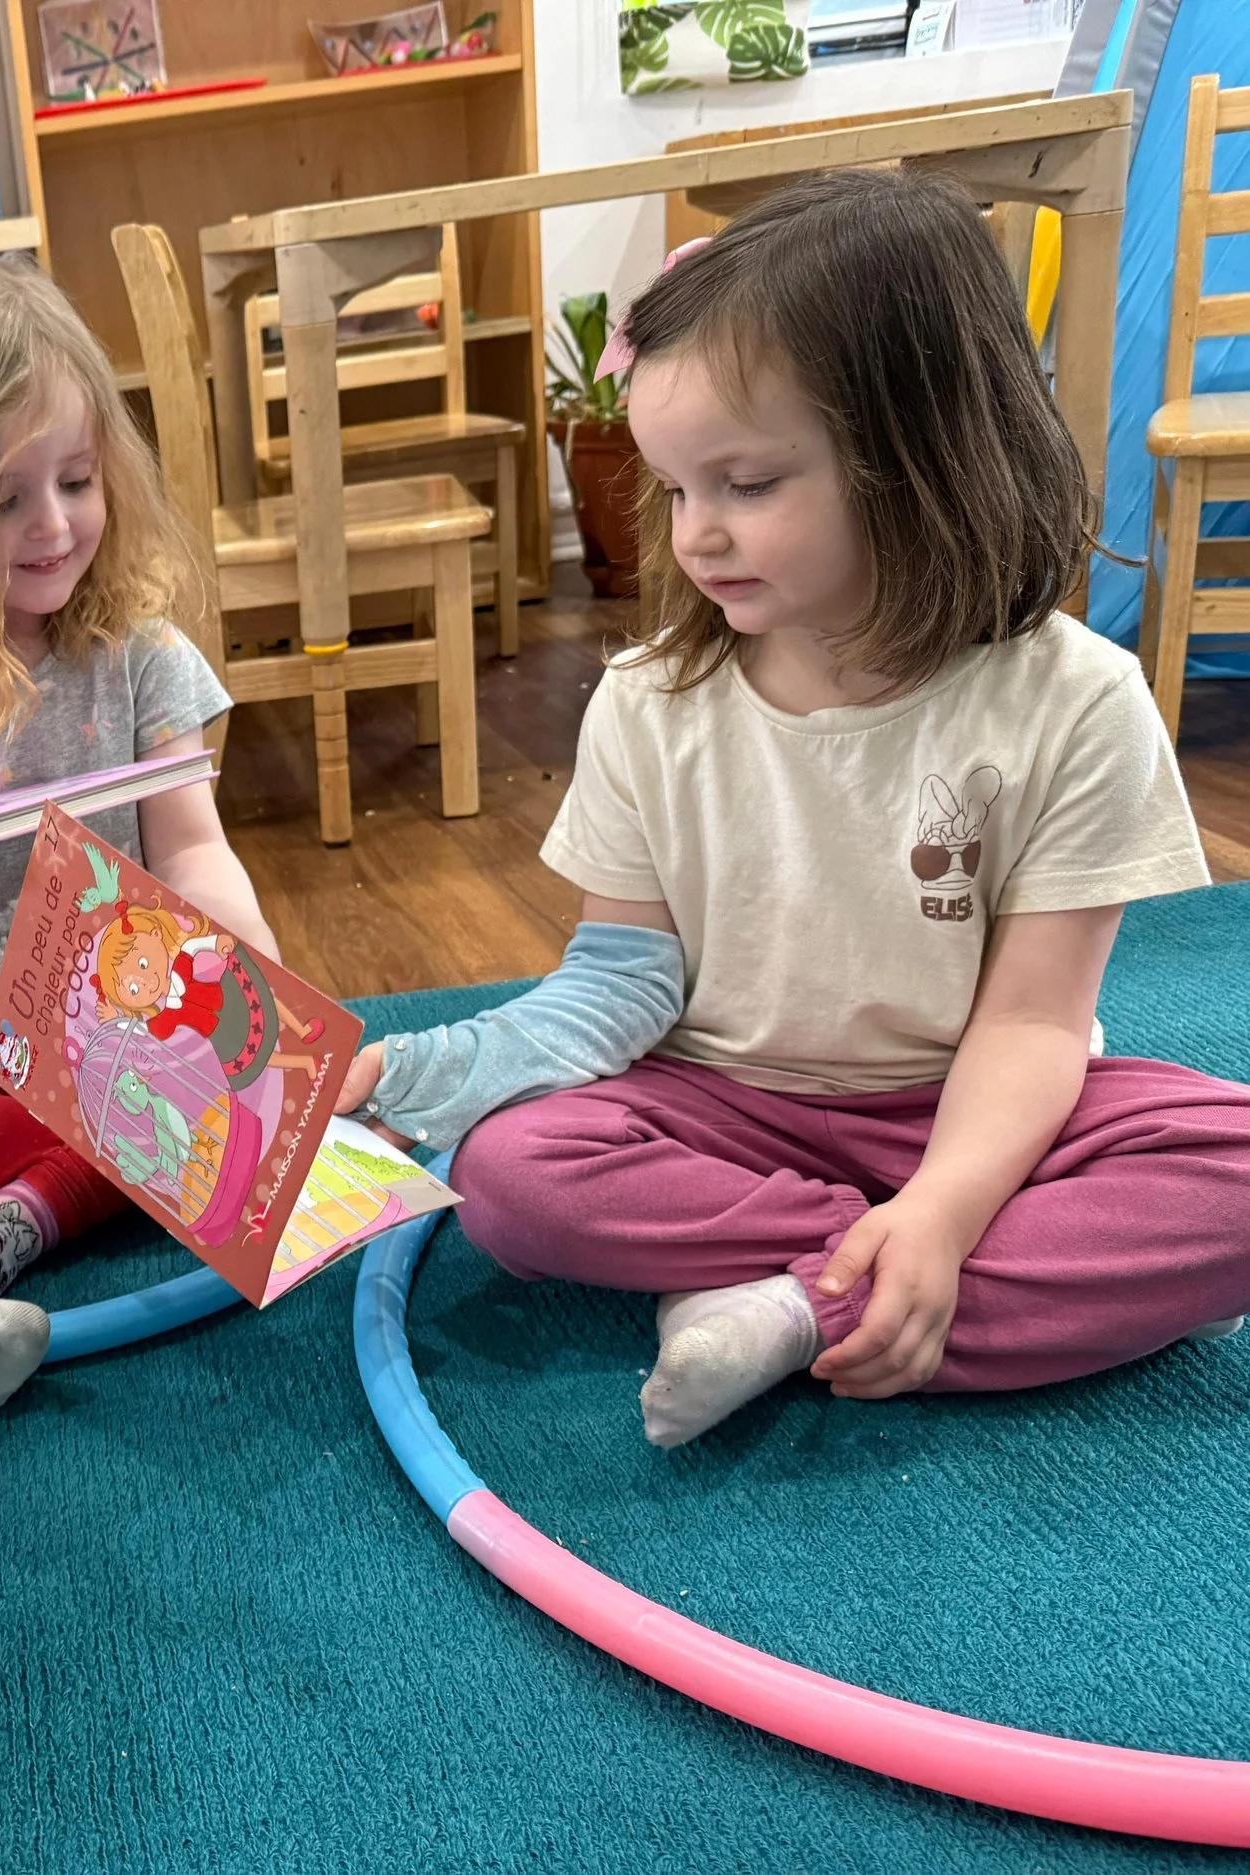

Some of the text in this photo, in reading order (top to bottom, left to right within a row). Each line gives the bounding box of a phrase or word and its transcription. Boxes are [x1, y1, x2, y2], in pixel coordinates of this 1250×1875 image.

[44, 815, 60, 851] 17
[9, 969, 38, 1019] Un
[31, 915, 54, 966] peu
[44, 875, 63, 911] de
[36, 892, 82, 1036] chaleur pour
[269, 1052, 333, 1200] MAISON YAMAMA
